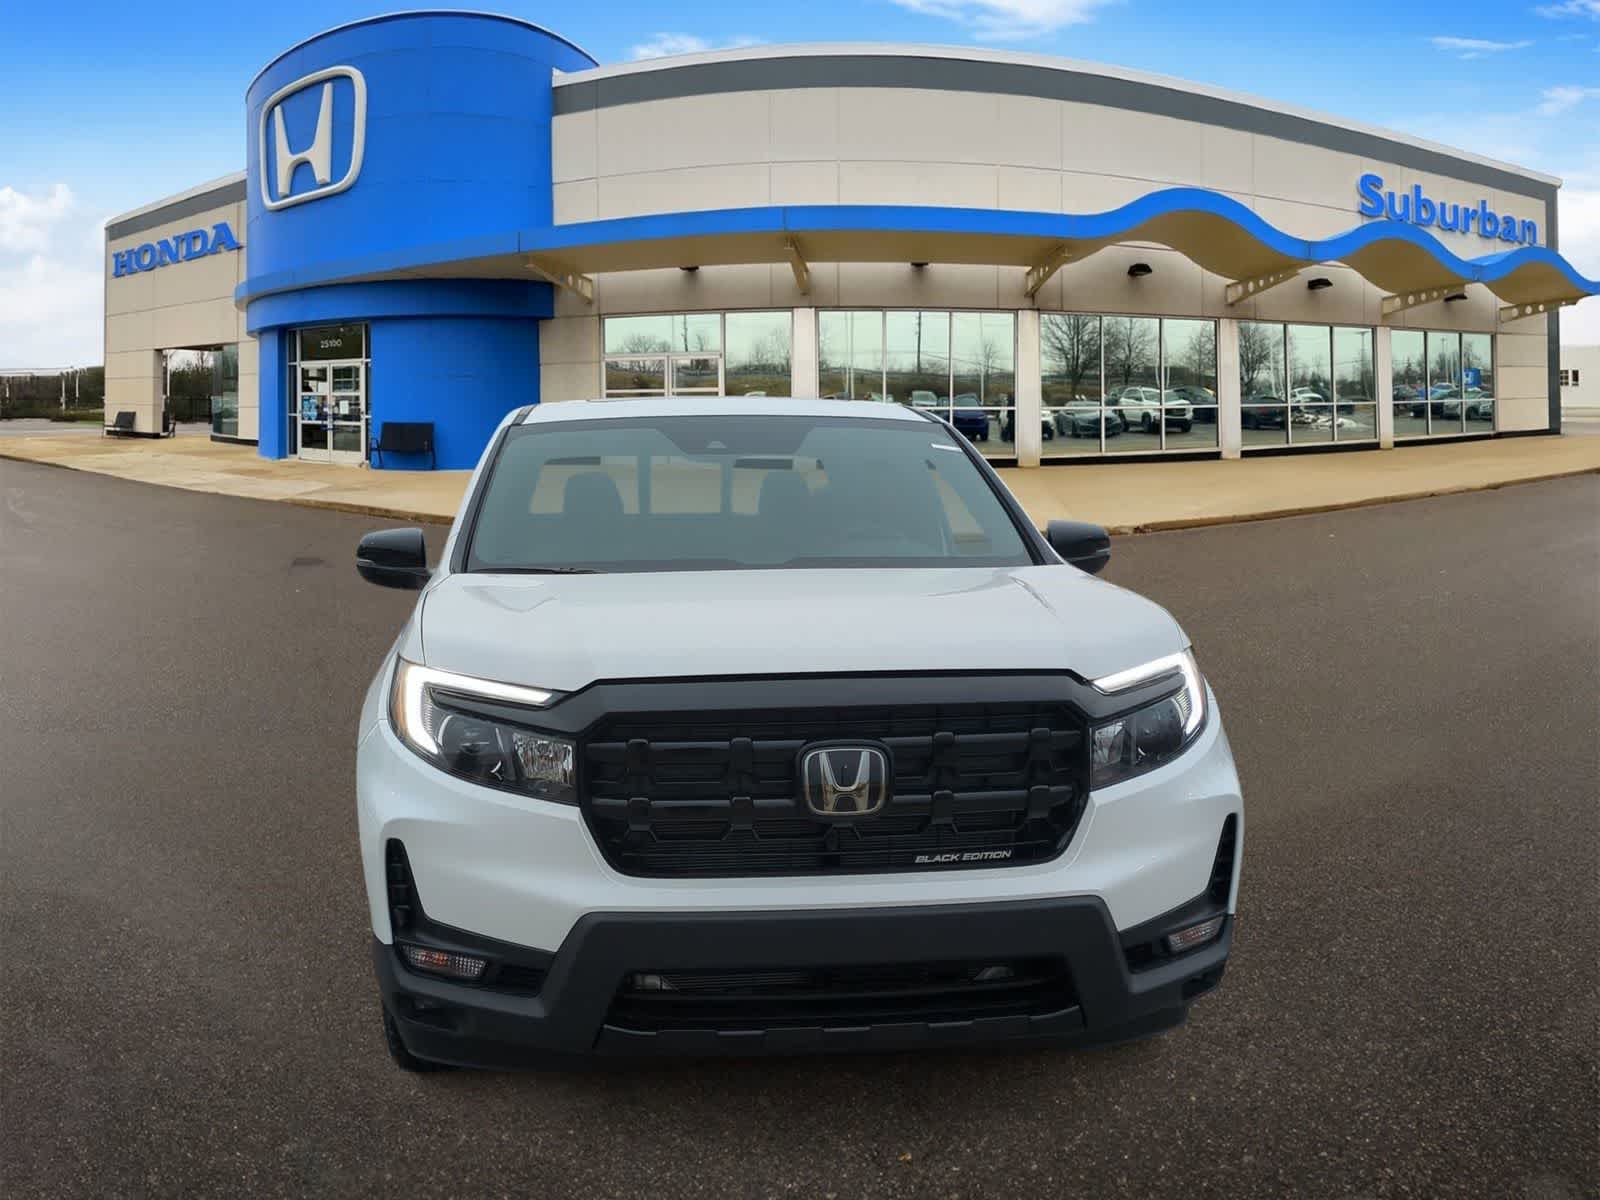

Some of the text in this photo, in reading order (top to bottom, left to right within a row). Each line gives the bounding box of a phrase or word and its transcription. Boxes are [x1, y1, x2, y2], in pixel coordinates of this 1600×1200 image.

[1358, 173, 1537, 245] Suburban
[112, 221, 242, 278] HONDA
[914, 850, 1012, 864] BLACK EDITION
